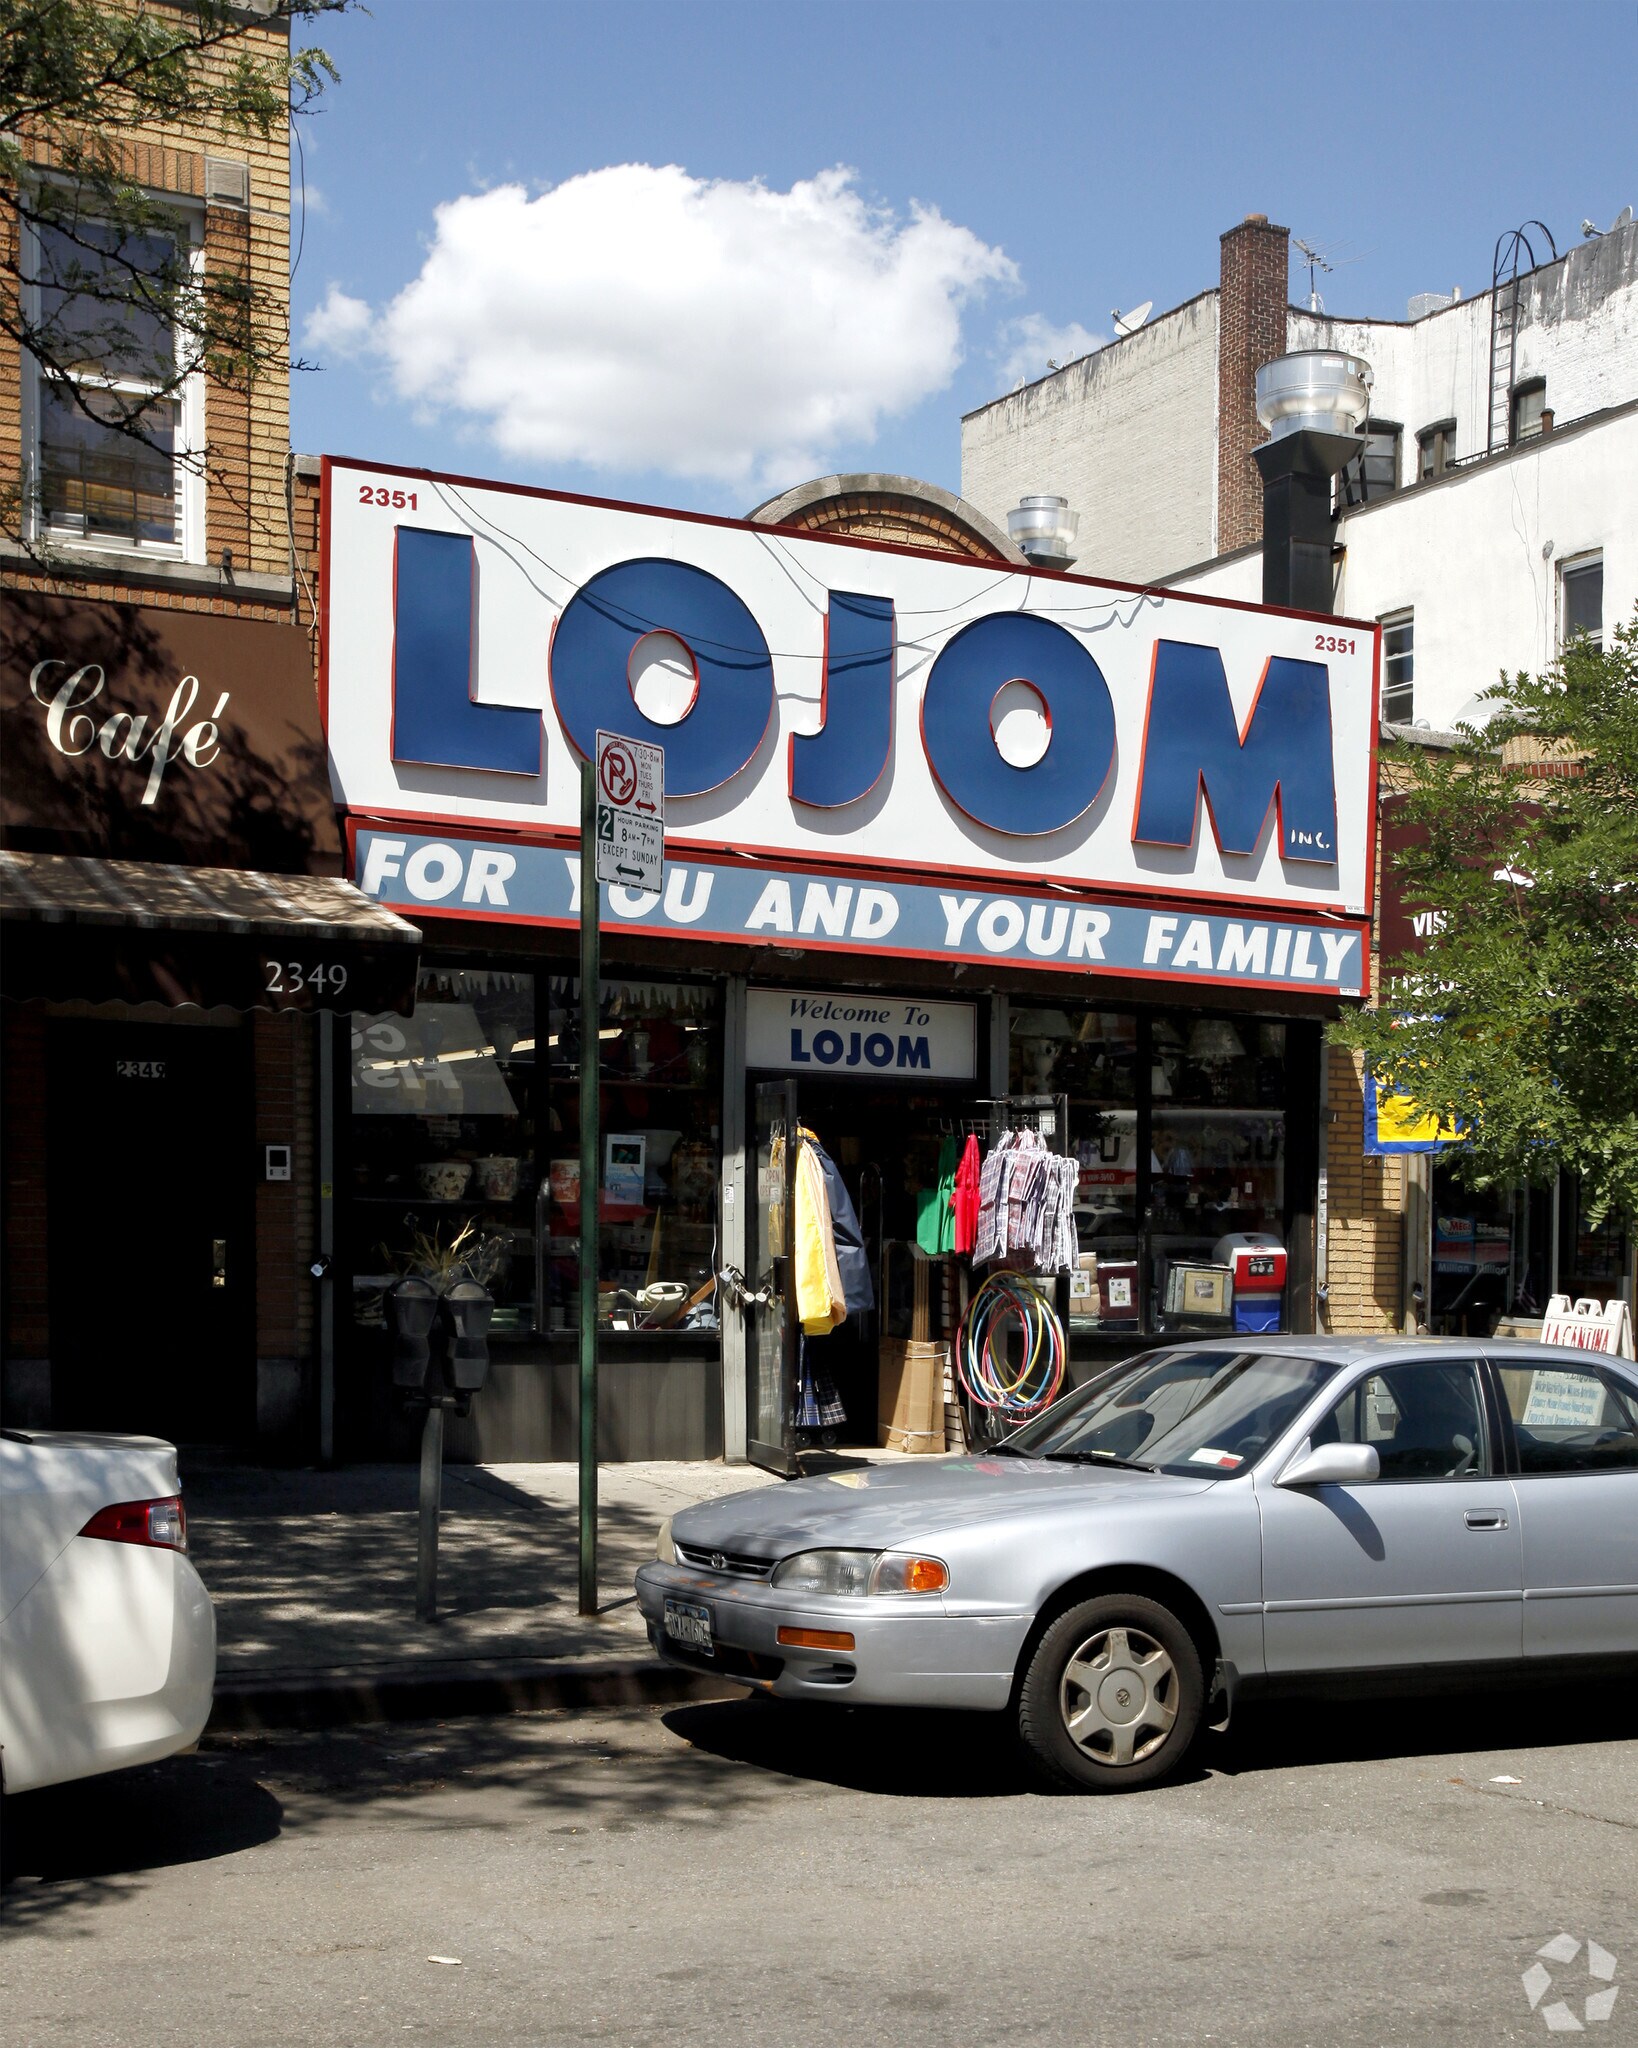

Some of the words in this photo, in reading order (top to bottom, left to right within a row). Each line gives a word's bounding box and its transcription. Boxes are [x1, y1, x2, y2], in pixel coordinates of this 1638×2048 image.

[359, 485, 417, 511] 2351
[1315, 635, 1356, 655] 2351
[390, 524, 1338, 866] LOJOM
[29, 659, 230, 805] Café
[639, 771, 652, 780] TUES
[640, 762, 652, 770] MON
[638, 780, 654, 790] THURS
[641, 790, 651, 799] FRI
[601, 808, 612, 838] 2
[617, 817, 633, 826] HOUR
[634, 821, 659, 832] PARKING
[1291, 829, 1330, 849] INC.
[602, 843, 628, 859] EXCEPT
[632, 850, 659, 865] SUNDAY
[359, 837, 517, 906] FOR
[744, 878, 900, 939] AND
[939, 894, 1111, 960] YOUR
[1142, 916, 1357, 980] FAMILY
[265, 961, 348, 996] 2349
[790, 999, 890, 1023] Welcome
[904, 1006, 930, 1026] To
[790, 1028, 931, 1069] LOJOM
[117, 1061, 166, 1078] 2349
[1437, 1262, 1470, 1273] Million
